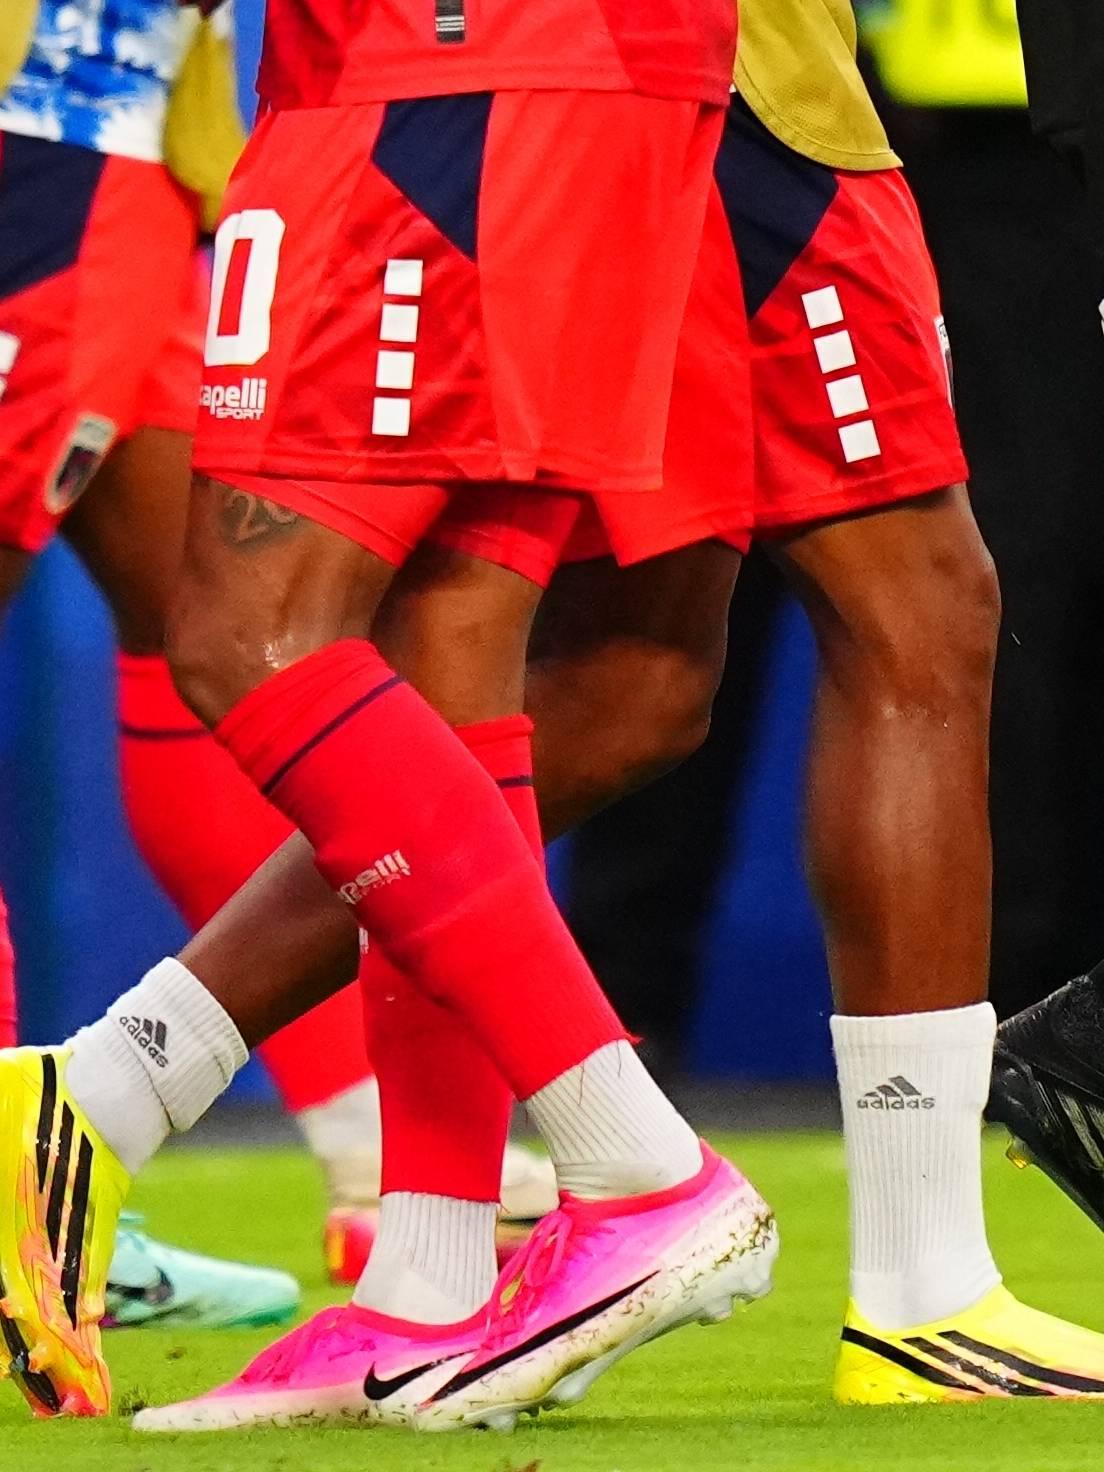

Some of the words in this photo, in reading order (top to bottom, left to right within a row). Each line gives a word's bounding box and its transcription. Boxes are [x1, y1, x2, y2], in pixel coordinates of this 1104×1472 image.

[216, 406, 265, 420] SPORT
[118, 1014, 170, 1069] adidas
[855, 1093, 937, 1111] adidas
